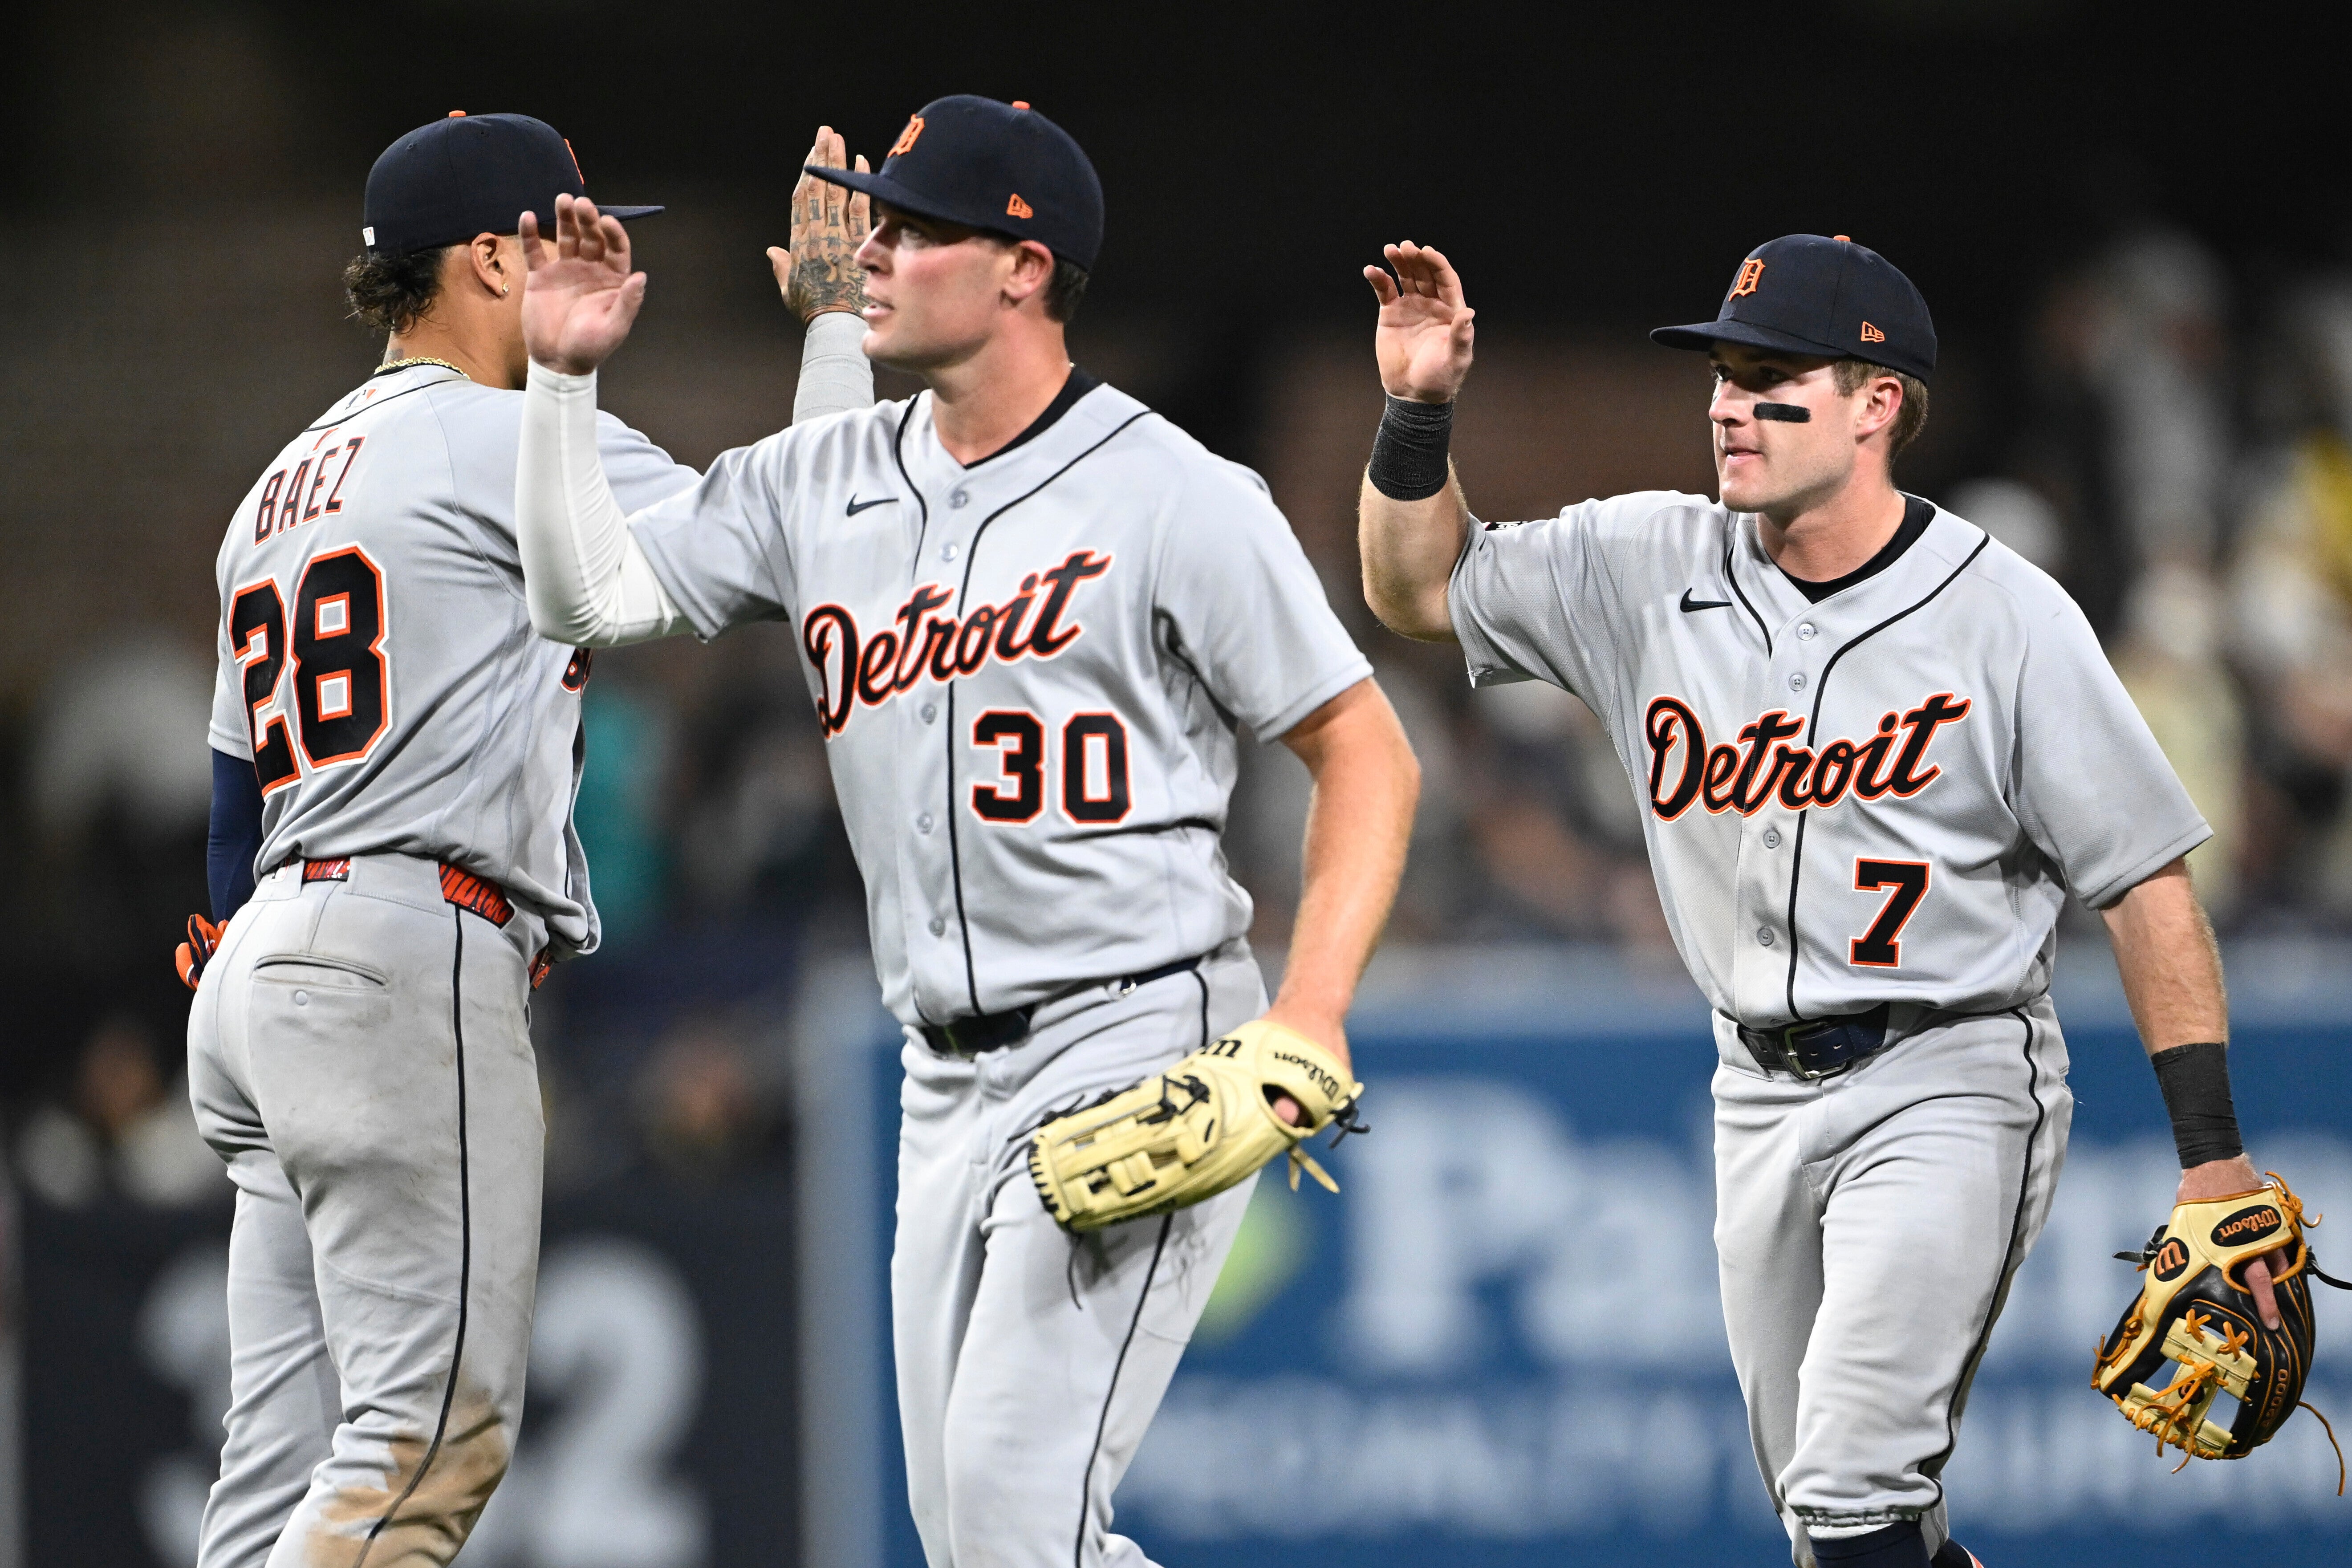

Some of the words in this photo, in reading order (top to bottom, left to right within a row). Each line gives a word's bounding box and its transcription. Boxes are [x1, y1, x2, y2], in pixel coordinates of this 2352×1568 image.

[1728, 257, 1766, 302] D
[255, 428, 364, 546] BÁEZ
[229, 544, 392, 797] 28
[803, 548, 1114, 740] Detroit
[970, 710, 1135, 827] 30
[1646, 691, 1971, 824] Detroit
[1848, 856, 1932, 969] 7
[1273, 1051, 1339, 1102] Wilson
[2157, 1242, 2186, 1275] W
[2219, 1209, 2279, 1238] Wilson
